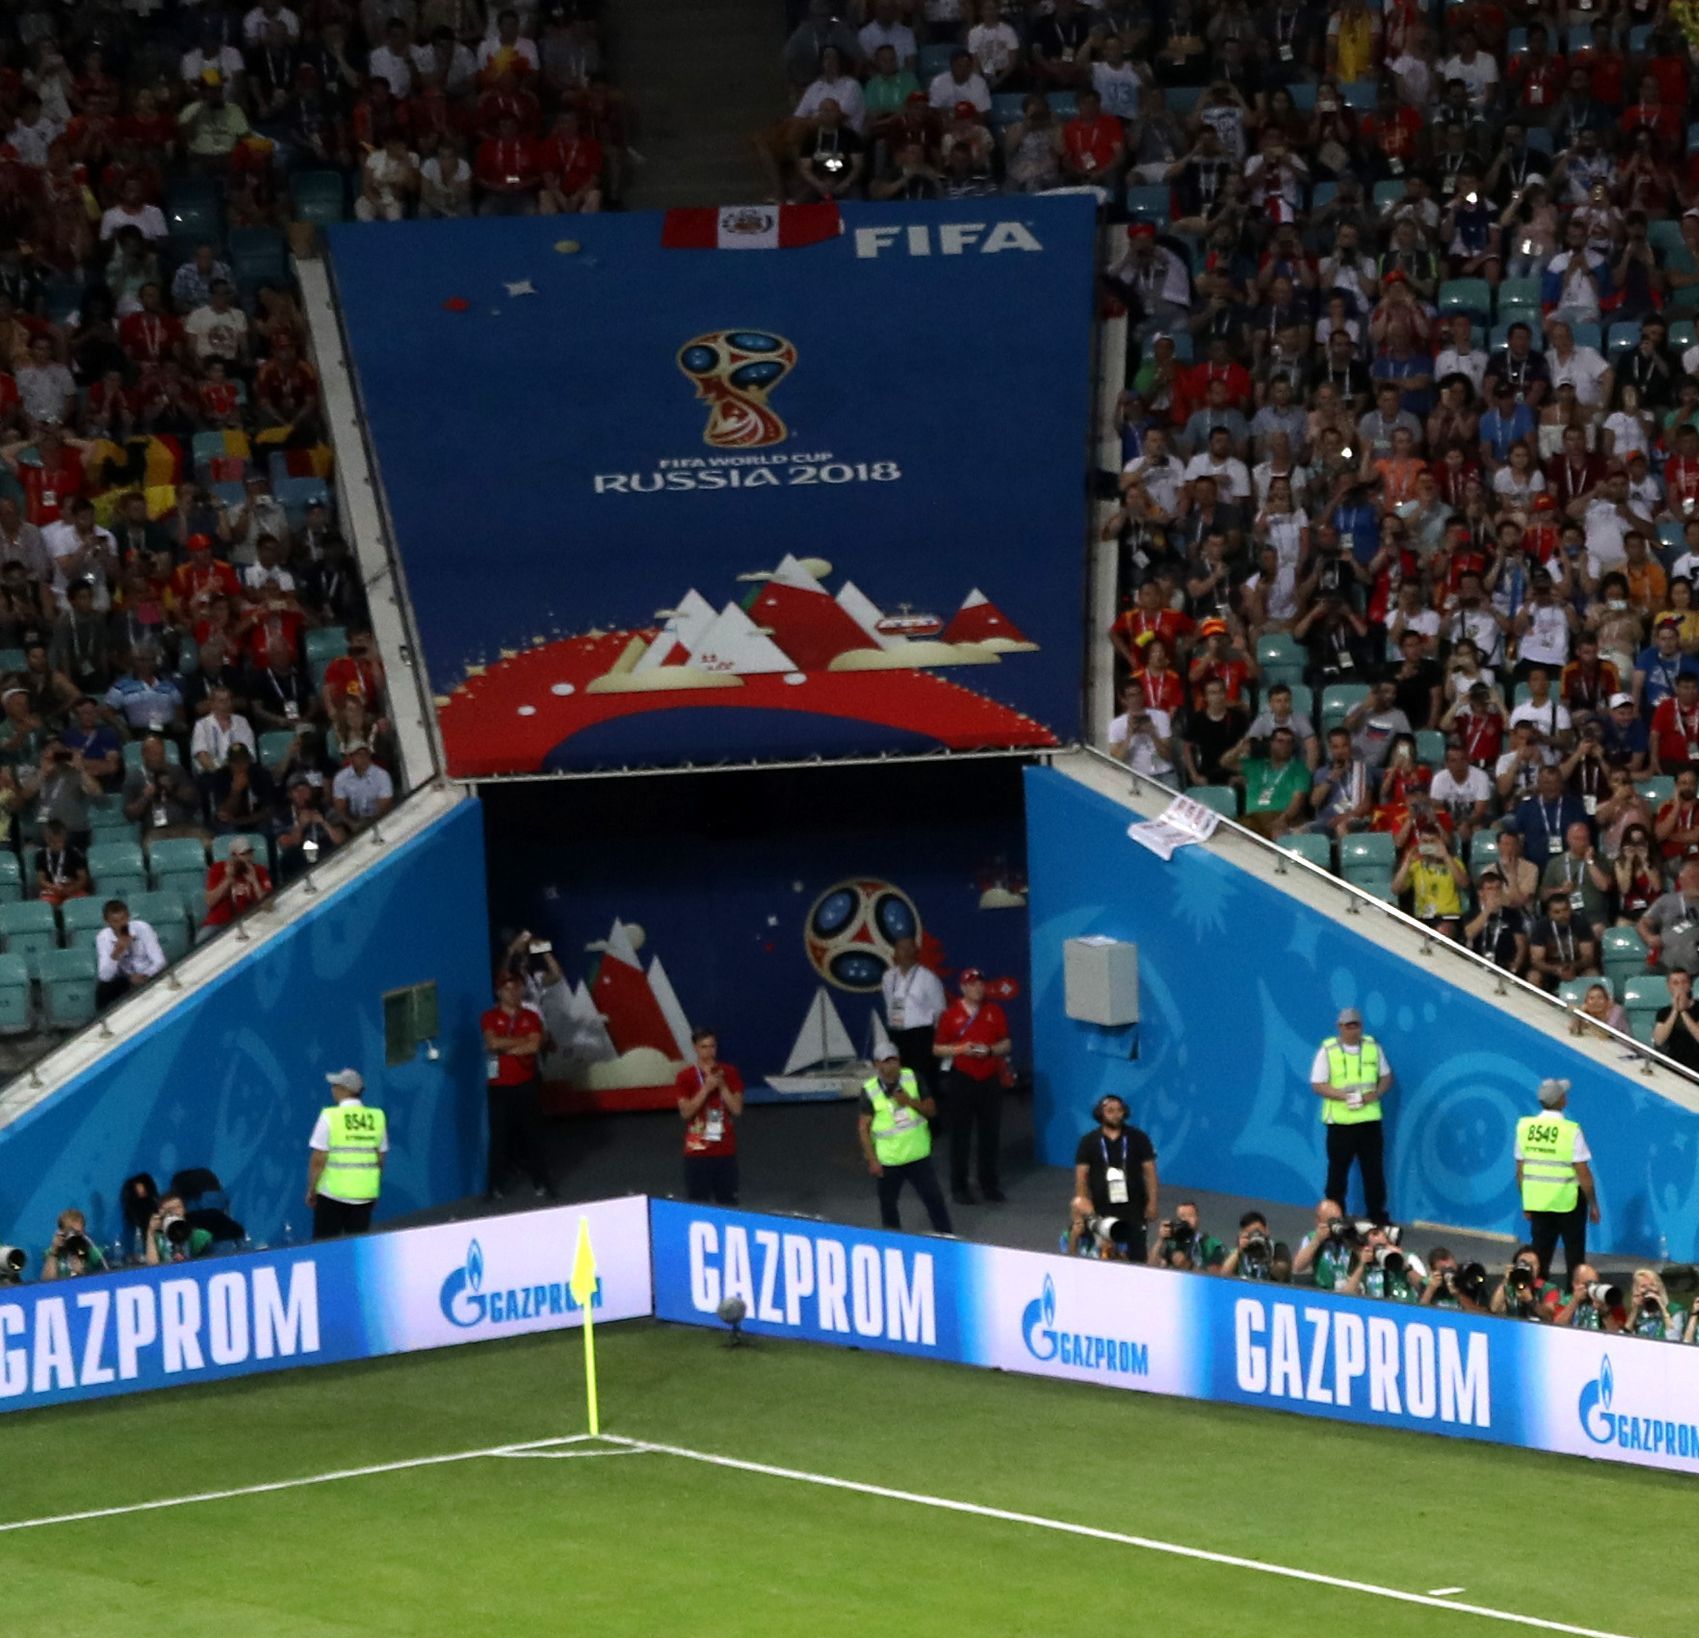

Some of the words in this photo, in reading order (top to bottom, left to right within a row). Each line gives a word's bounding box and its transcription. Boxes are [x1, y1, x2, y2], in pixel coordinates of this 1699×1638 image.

[855, 221, 1043, 259] FIFA
[594, 467, 782, 493] RUSSIA
[788, 462, 901, 485] 2018
[659, 457, 706, 470] FIFA
[708, 454, 788, 467] WORLD
[791, 452, 833, 463] CUP
[1527, 1124, 1558, 1144] 8549
[690, 1220, 936, 1346] GAZPROM
[0, 1261, 321, 1397] GAZPROM
[1060, 1332, 1149, 1376] GAZPROM
[1235, 1299, 1490, 1428] GAZPROM
